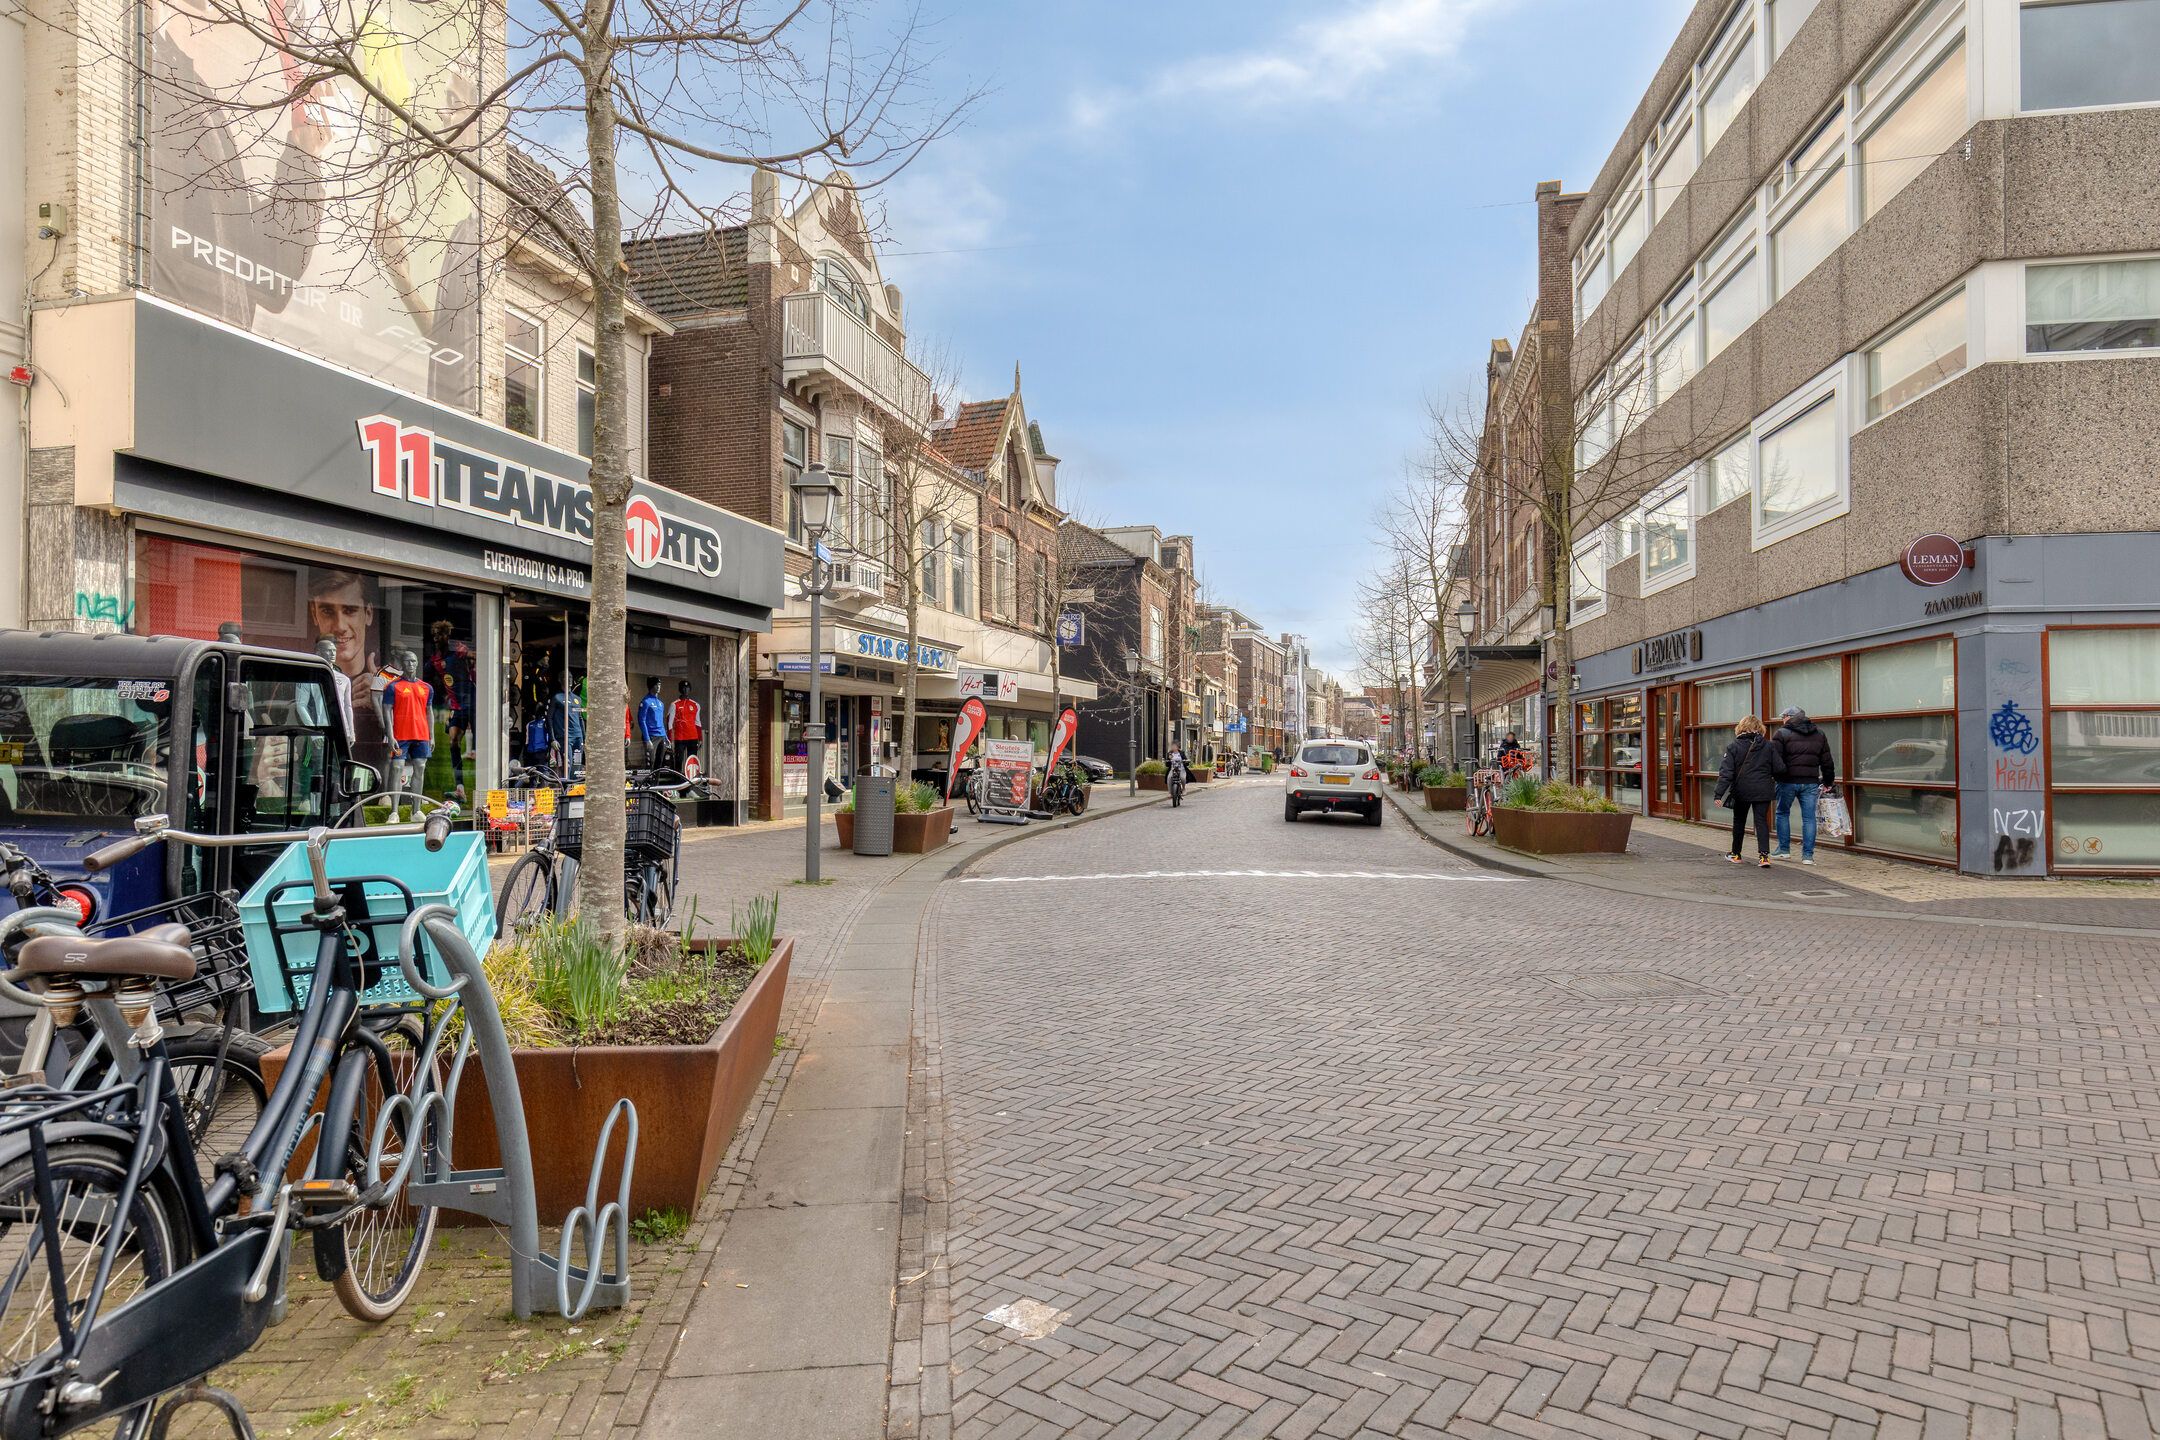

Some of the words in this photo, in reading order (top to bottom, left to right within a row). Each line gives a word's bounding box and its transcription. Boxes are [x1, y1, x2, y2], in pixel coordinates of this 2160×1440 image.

[172, 225, 327, 313] PREDATOR
[340, 300, 364, 329] OR
[484, 550, 544, 580] EVERYBODY
[547, 563, 556, 583] IS
[557, 567, 565, 586] A
[567, 567, 585, 589] PRO
[1913, 554, 1959, 564] LEMAN
[1924, 591, 1983, 615] ZAANDAM
[858, 633, 893, 660] STAR
[931, 649, 945, 669] PC
[1644, 631, 1687, 667] LEMAN
[118, 690, 155, 700] GIRL
[64, 952, 88, 963] SR
